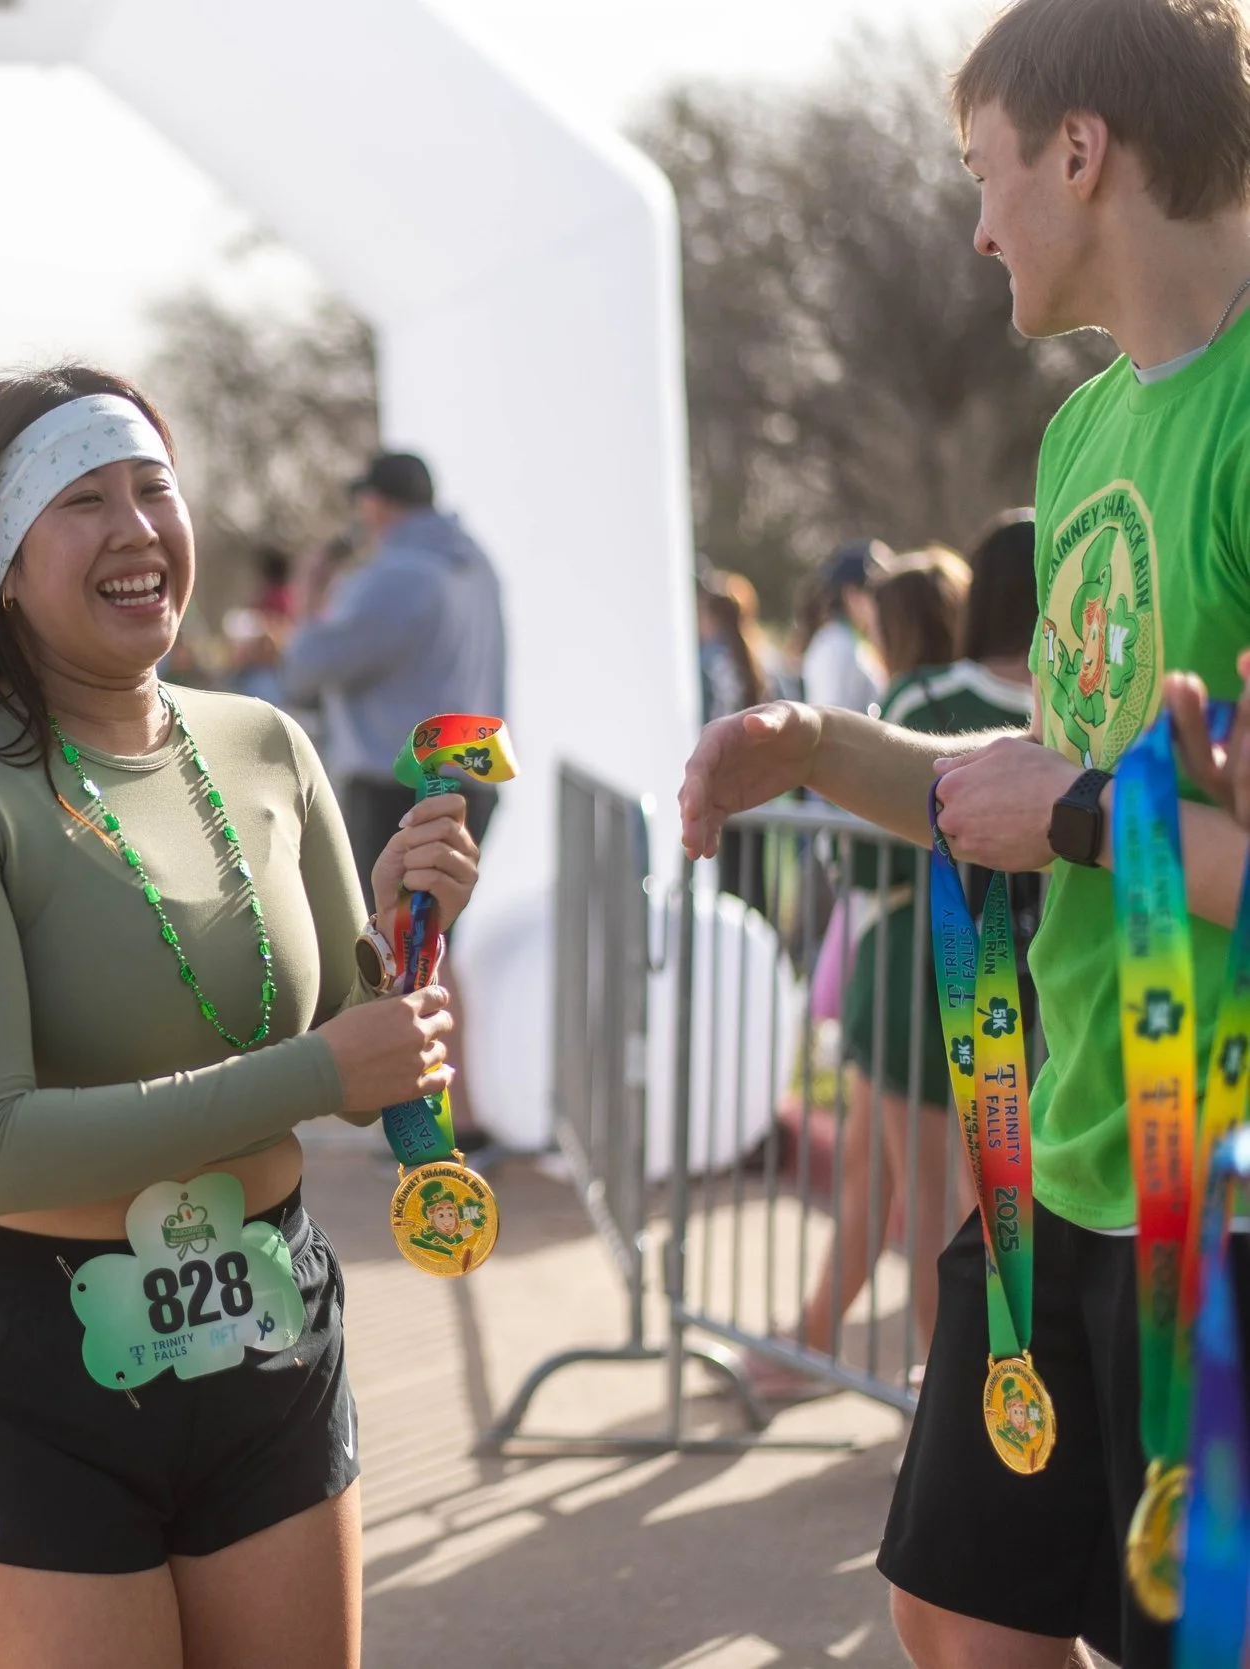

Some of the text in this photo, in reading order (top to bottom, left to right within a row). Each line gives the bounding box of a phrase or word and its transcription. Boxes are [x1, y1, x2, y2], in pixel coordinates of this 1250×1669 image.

[1102, 494, 1146, 555] SHAOCK
[1134, 552, 1150, 609] RUN
[463, 756, 485, 769] 5K
[942, 909, 958, 977] TRINITY
[960, 926, 976, 979] FALLS
[984, 940, 997, 975] RUN
[993, 1008, 1008, 1030] 5K
[958, 1044, 971, 1064] 5K
[390, 1107, 419, 1158] TRINI
[986, 1095, 1001, 1149] FALLS
[1004, 1095, 1021, 1165] TRINITY
[420, 1167, 469, 1184] SHAMROCK
[468, 1180, 485, 1199] RUN
[462, 1206, 480, 1220] 5K
[994, 1184, 1020, 1253] 2025
[143, 1251, 253, 1334] 828
[152, 1333, 194, 1351] TRINITY
[154, 1346, 188, 1362] FALLS
